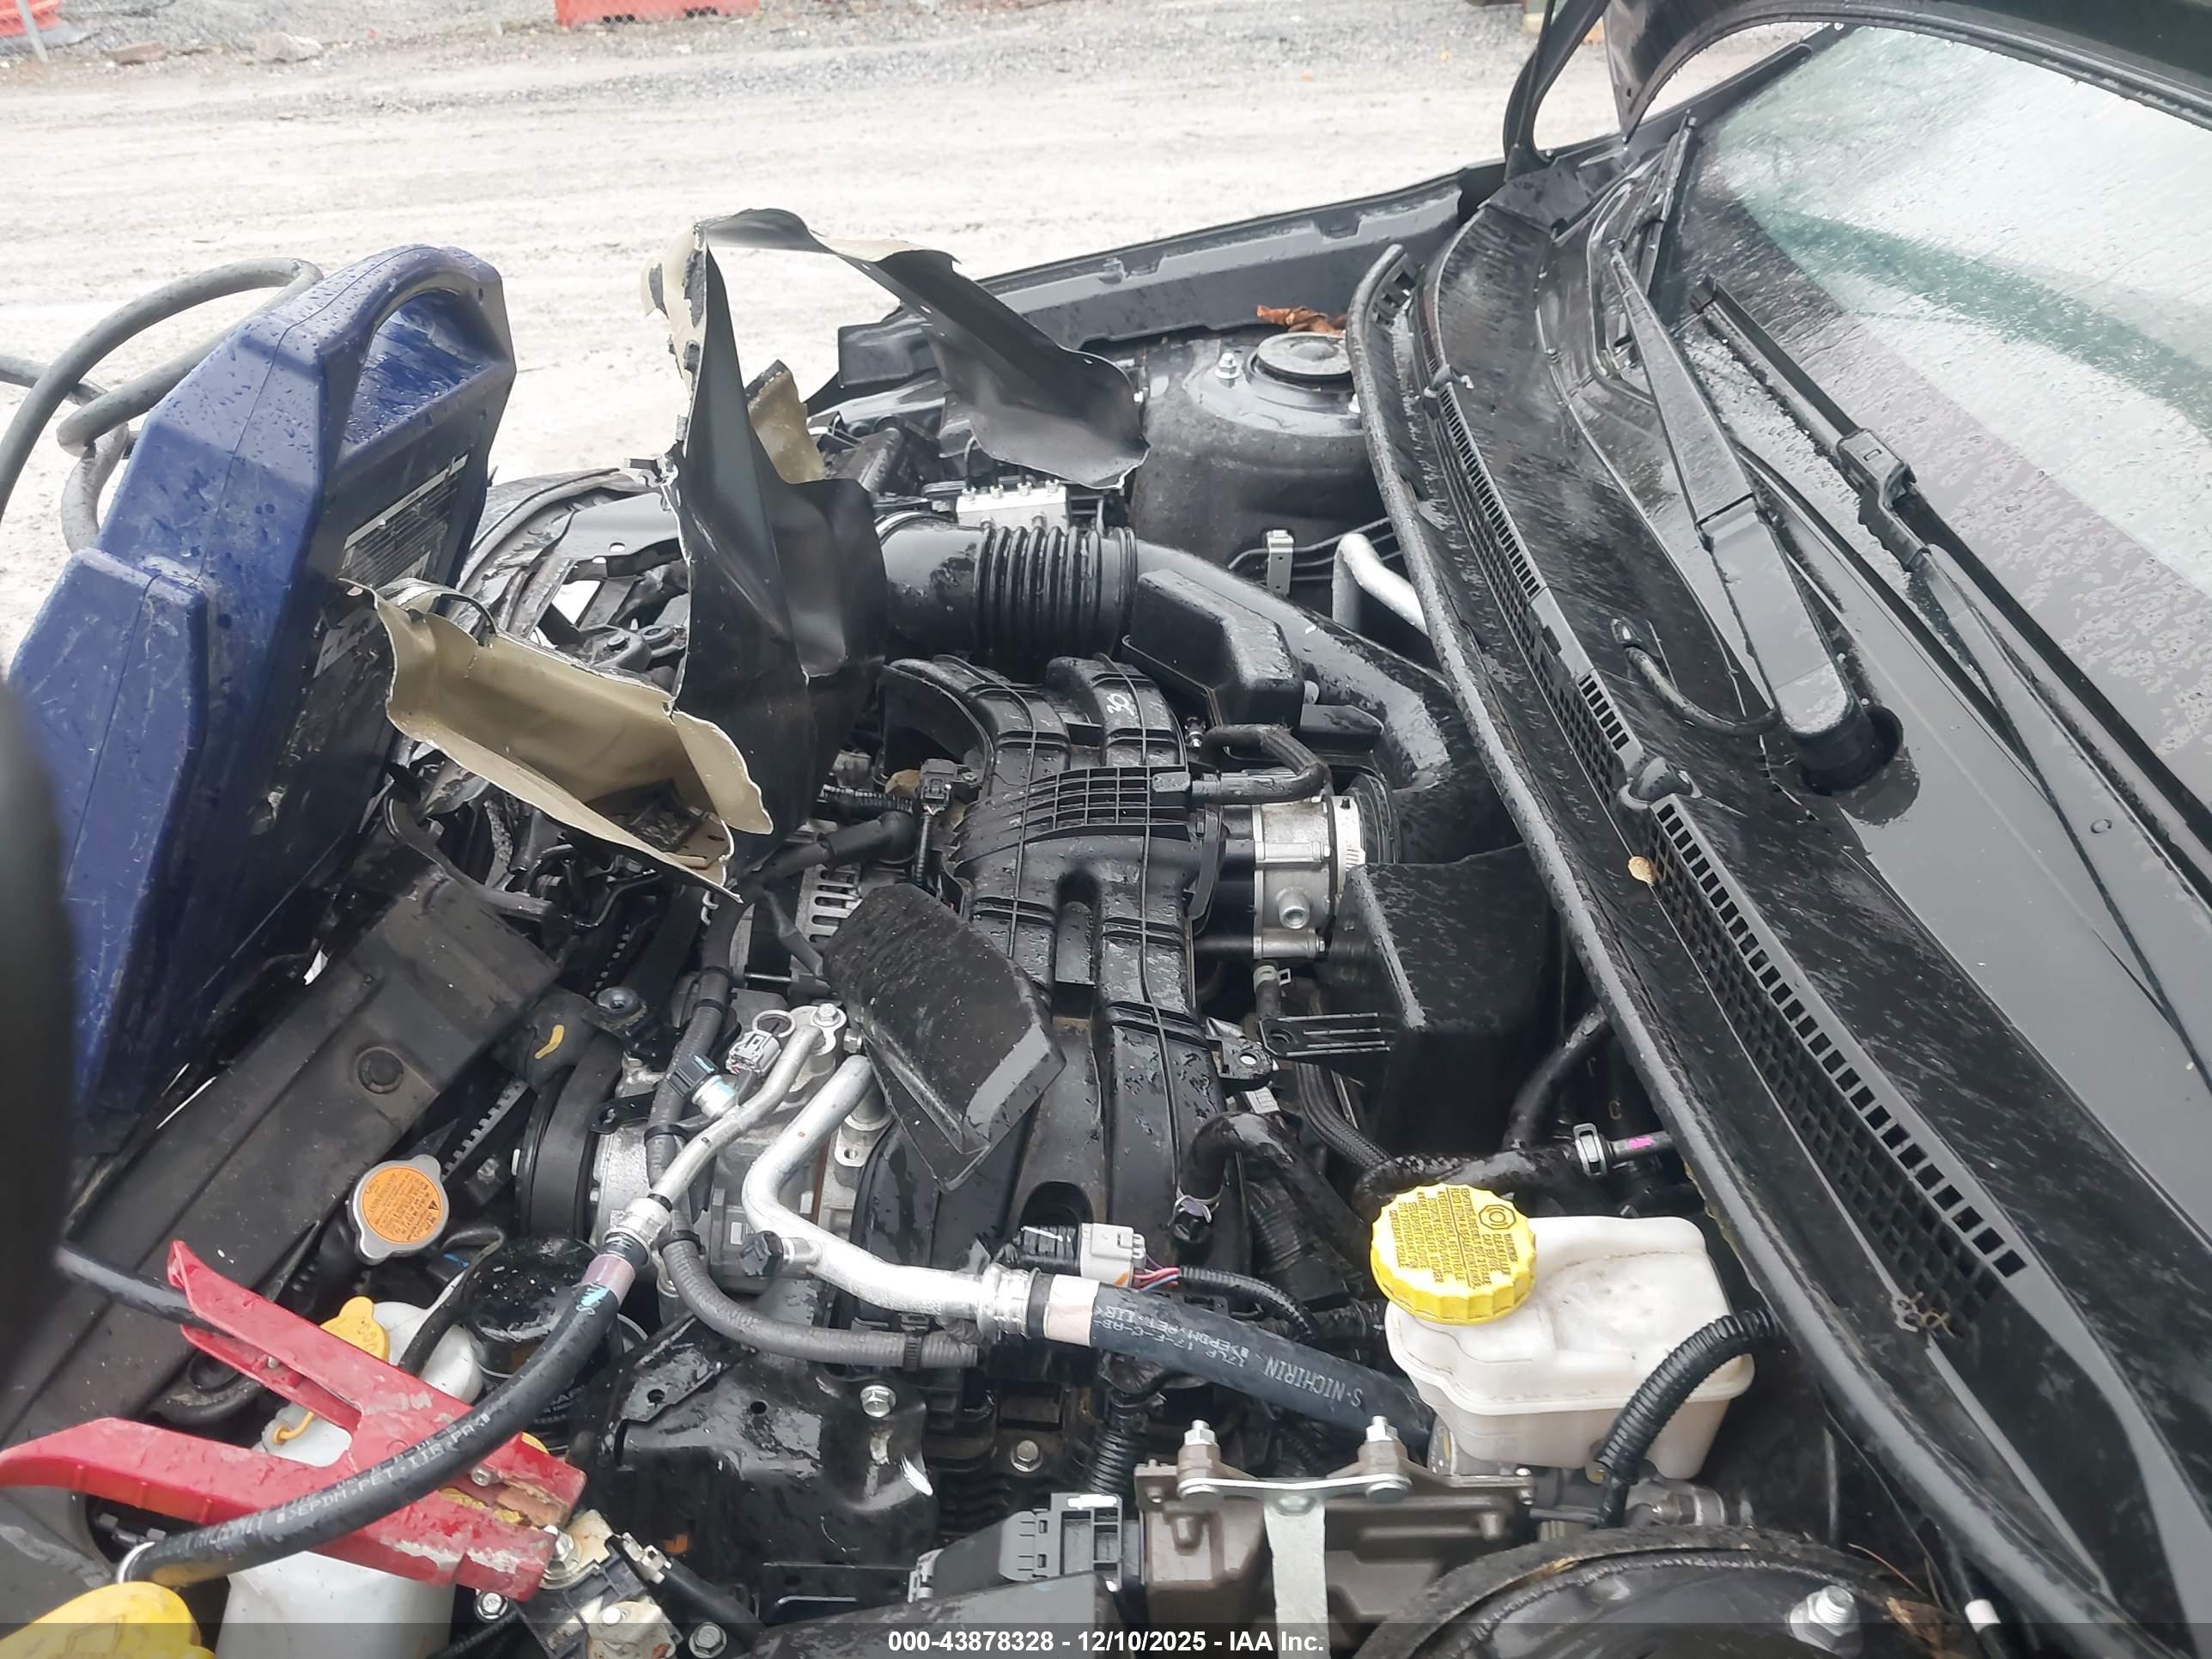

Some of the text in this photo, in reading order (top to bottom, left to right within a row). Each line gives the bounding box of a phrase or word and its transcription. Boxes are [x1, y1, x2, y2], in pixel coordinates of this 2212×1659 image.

[1417, 1192, 1429, 1211] AVANT
[1455, 1206, 1466, 1221] FROM
[1460, 1229, 1474, 1252] SEALED
[1482, 1234, 1500, 1272] CAP BEFORE
[1455, 1273, 1465, 1281] LE
[1479, 1264, 1492, 1285] BRAKE
